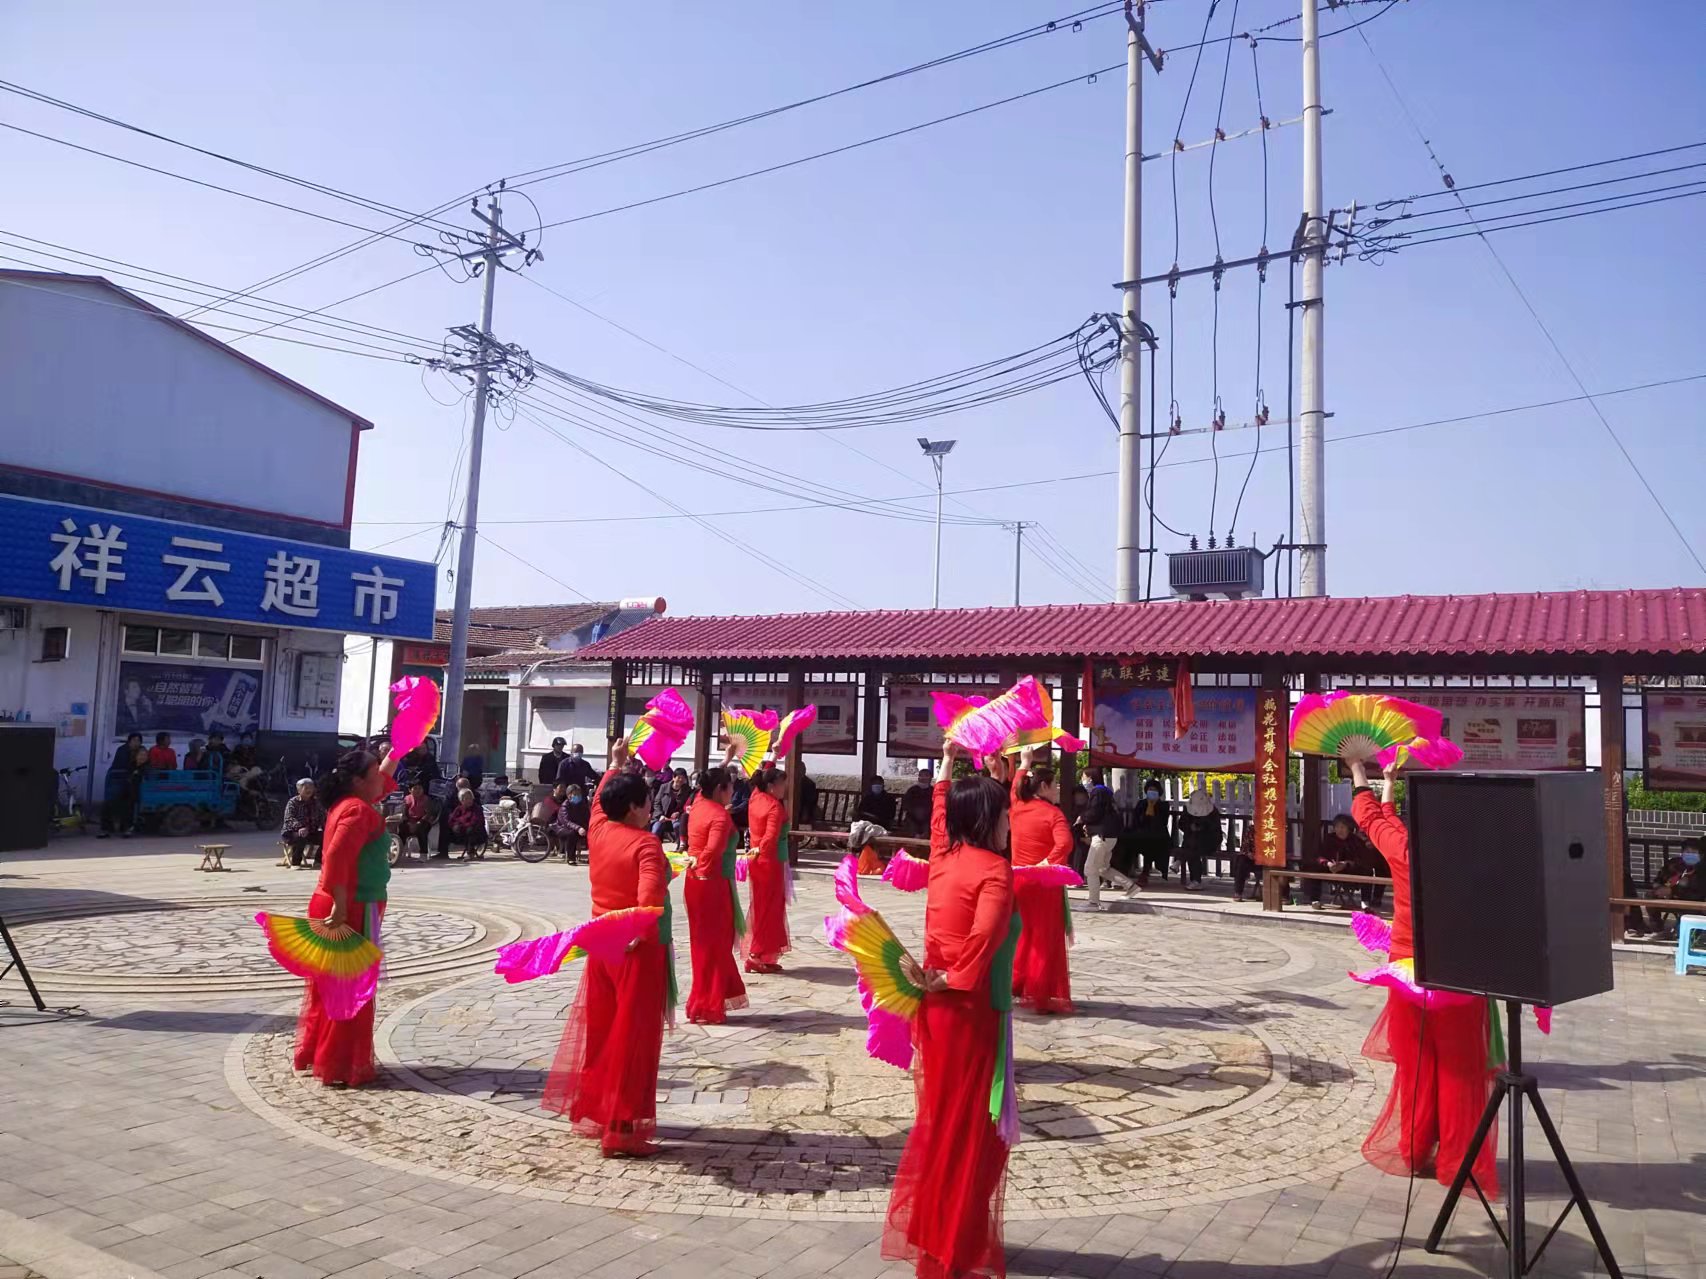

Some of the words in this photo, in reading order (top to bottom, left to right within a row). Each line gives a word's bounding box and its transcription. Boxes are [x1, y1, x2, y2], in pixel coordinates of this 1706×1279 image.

[50, 518, 405, 625] 祥云超市
[1101, 664, 1174, 682] 双联共建
